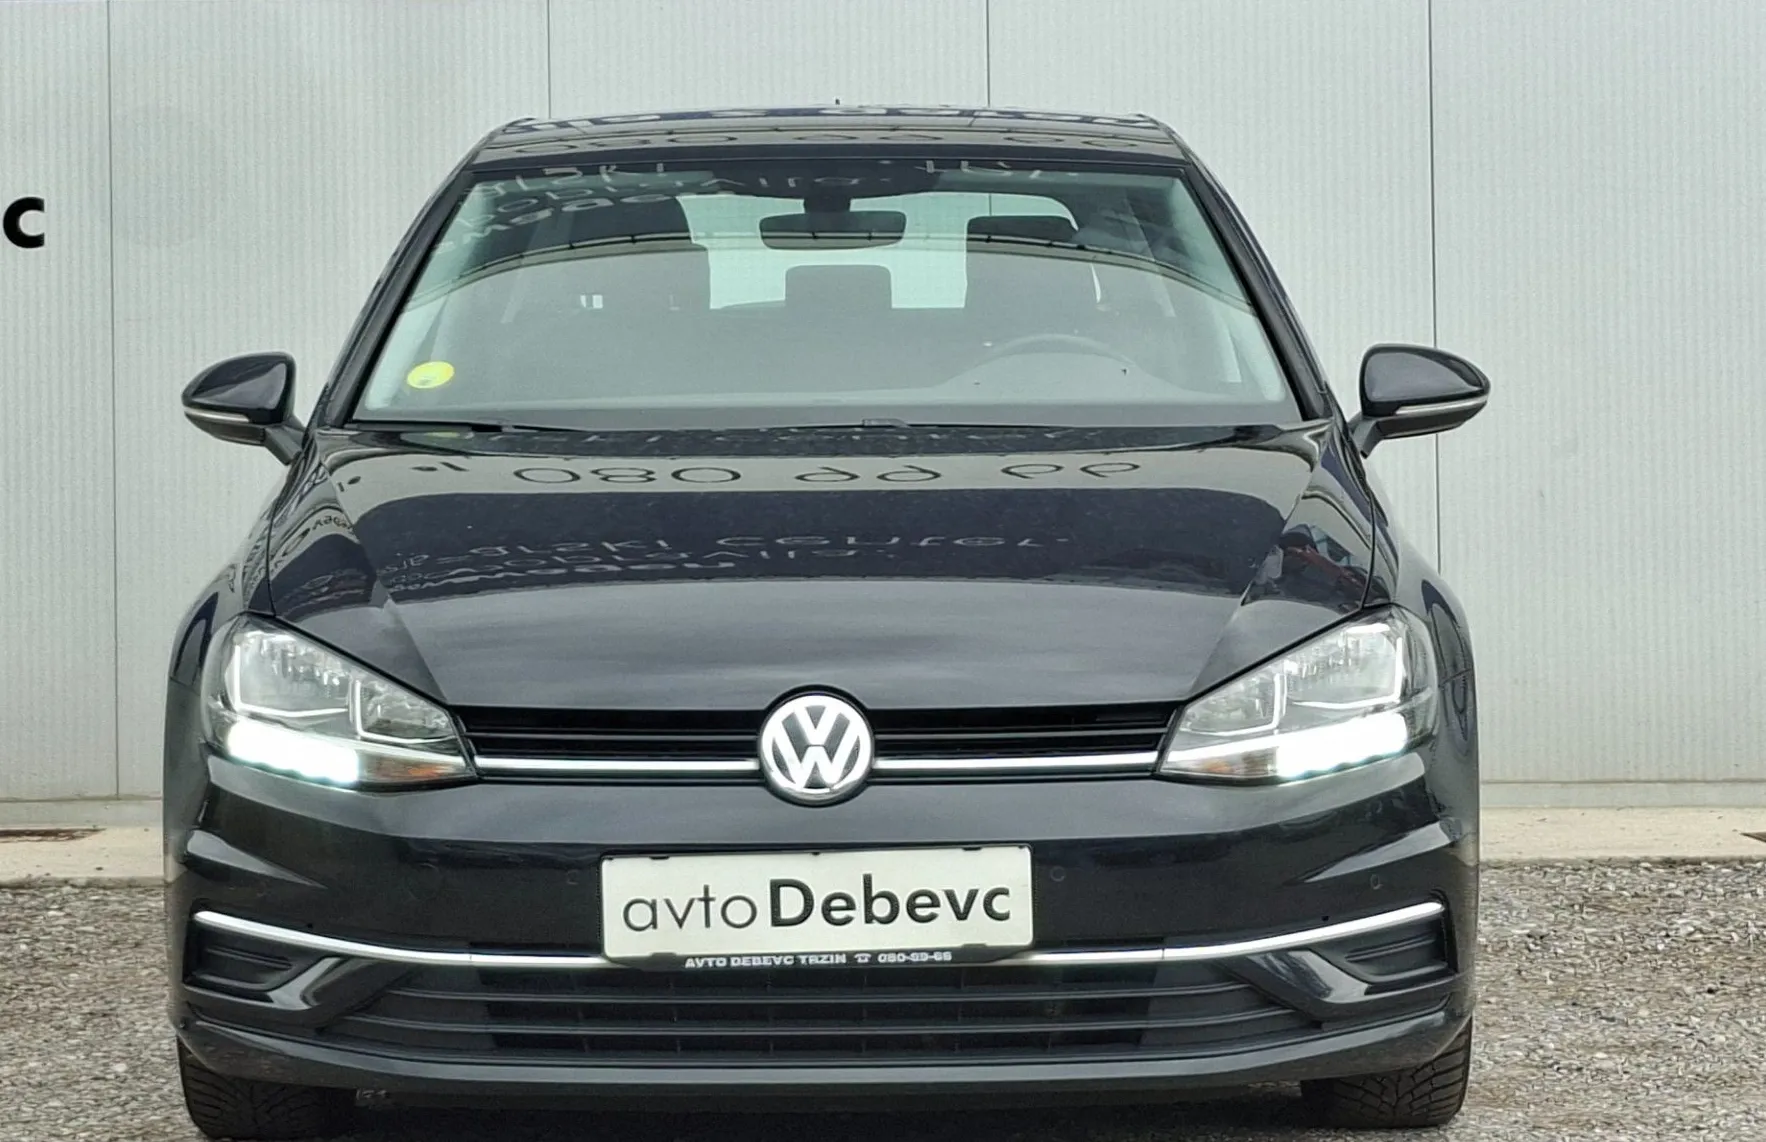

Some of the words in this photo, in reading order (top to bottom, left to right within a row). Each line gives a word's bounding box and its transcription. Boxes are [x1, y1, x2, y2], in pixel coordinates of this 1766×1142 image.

[762, 694, 871, 796] VW
[684, 956, 727, 969] AVTO
[730, 955, 795, 968] DEBEVC
[800, 953, 847, 966] TRZIN
